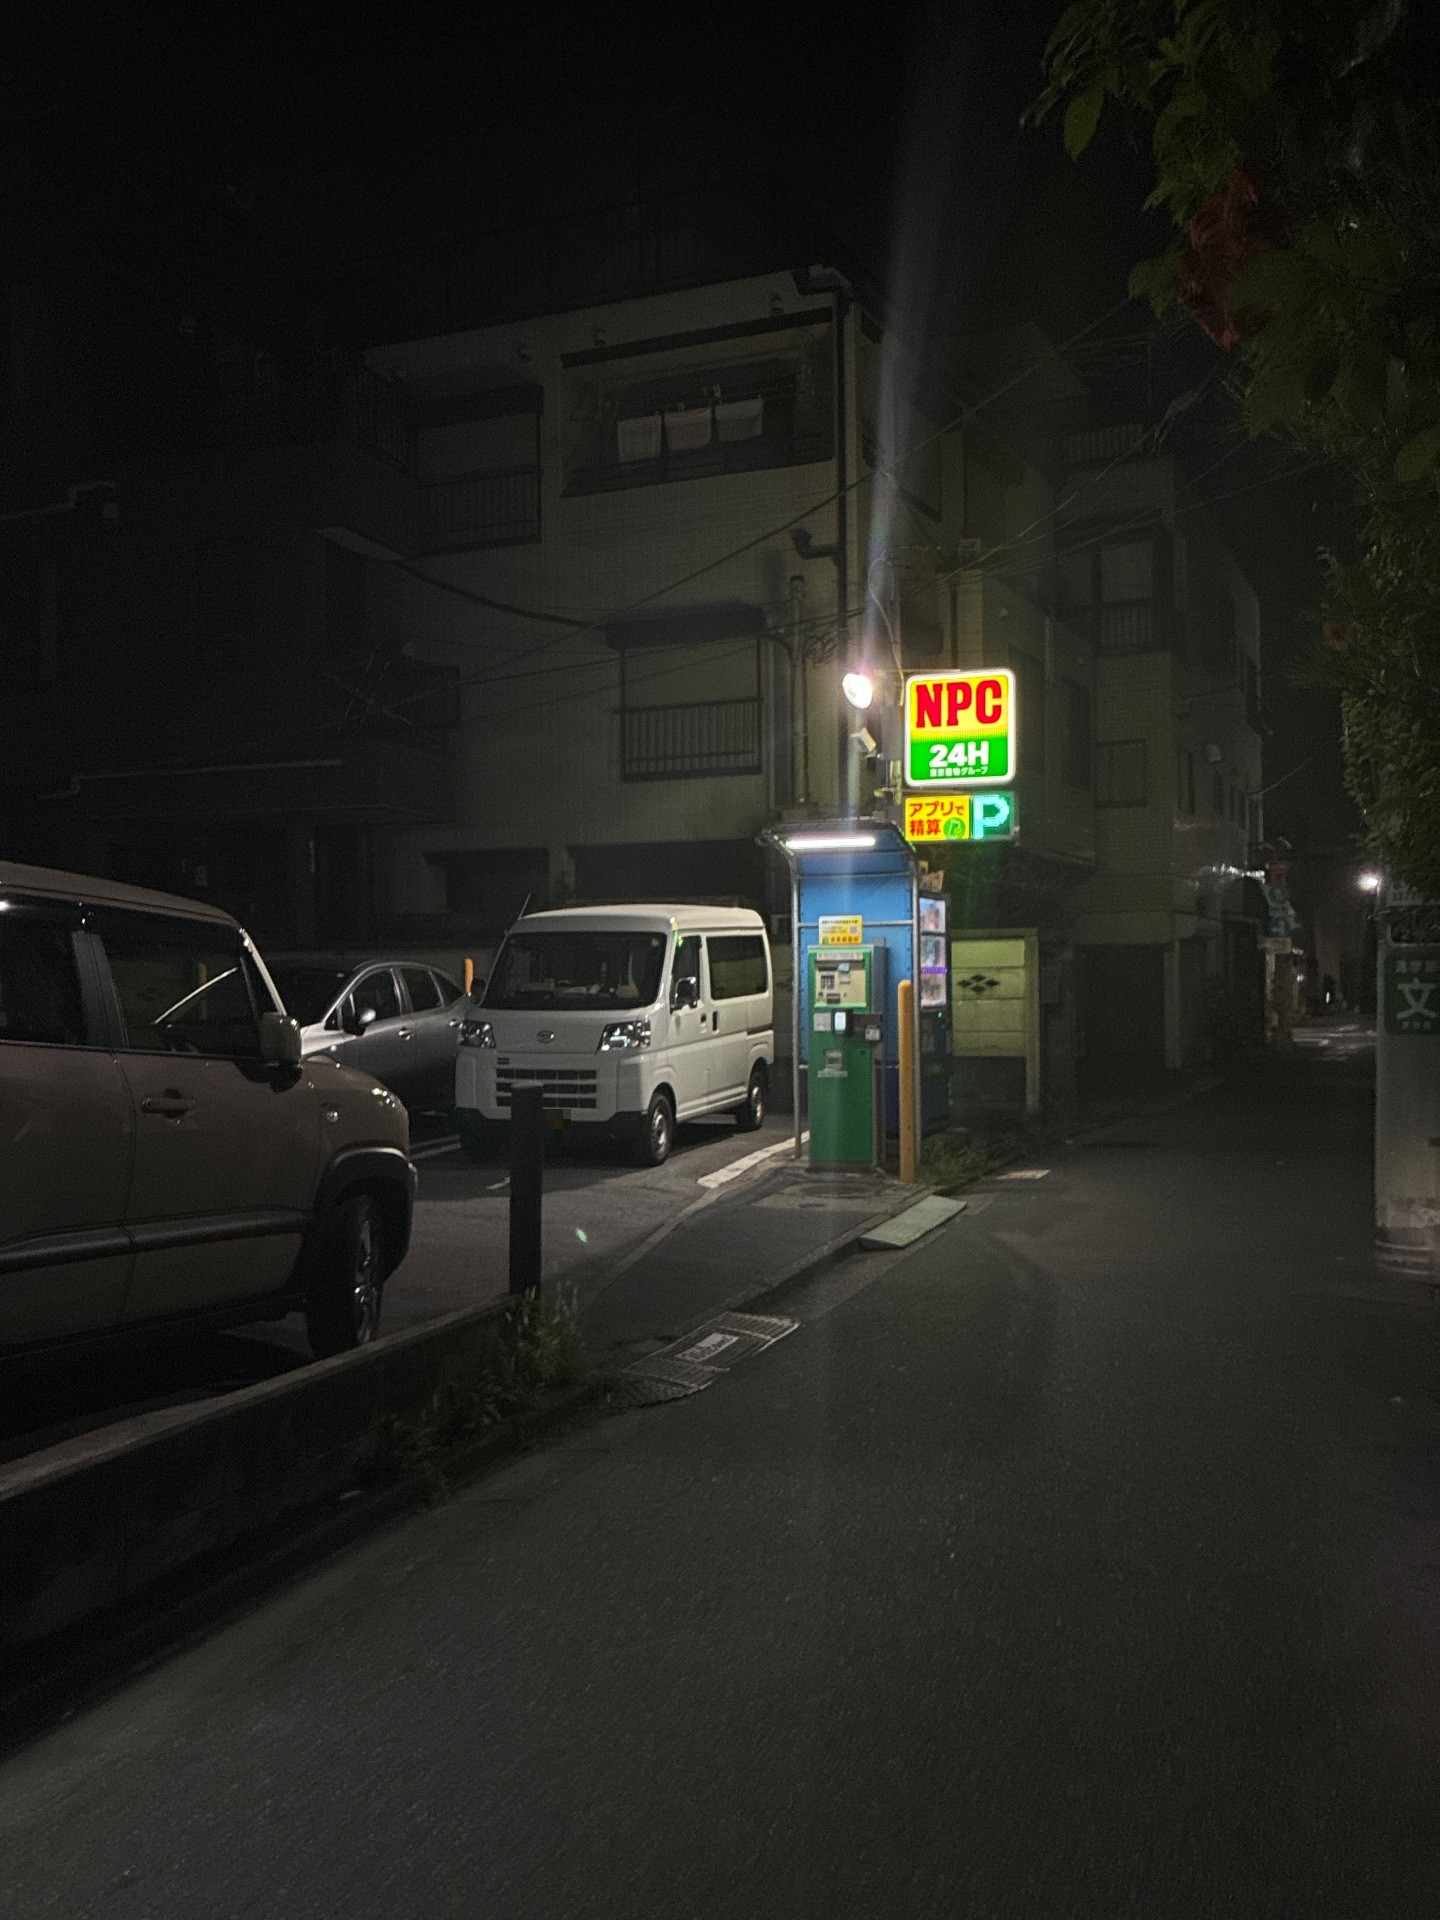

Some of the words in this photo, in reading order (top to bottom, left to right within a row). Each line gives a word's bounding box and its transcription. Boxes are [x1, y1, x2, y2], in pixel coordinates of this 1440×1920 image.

[916, 679, 1002, 728] NPC
[929, 741, 989, 768] 24H
[909, 801, 964, 817] アプリで
[973, 795, 1010, 840] P
[909, 819, 941, 836] 精算
[1396, 976, 1439, 1019] 文
